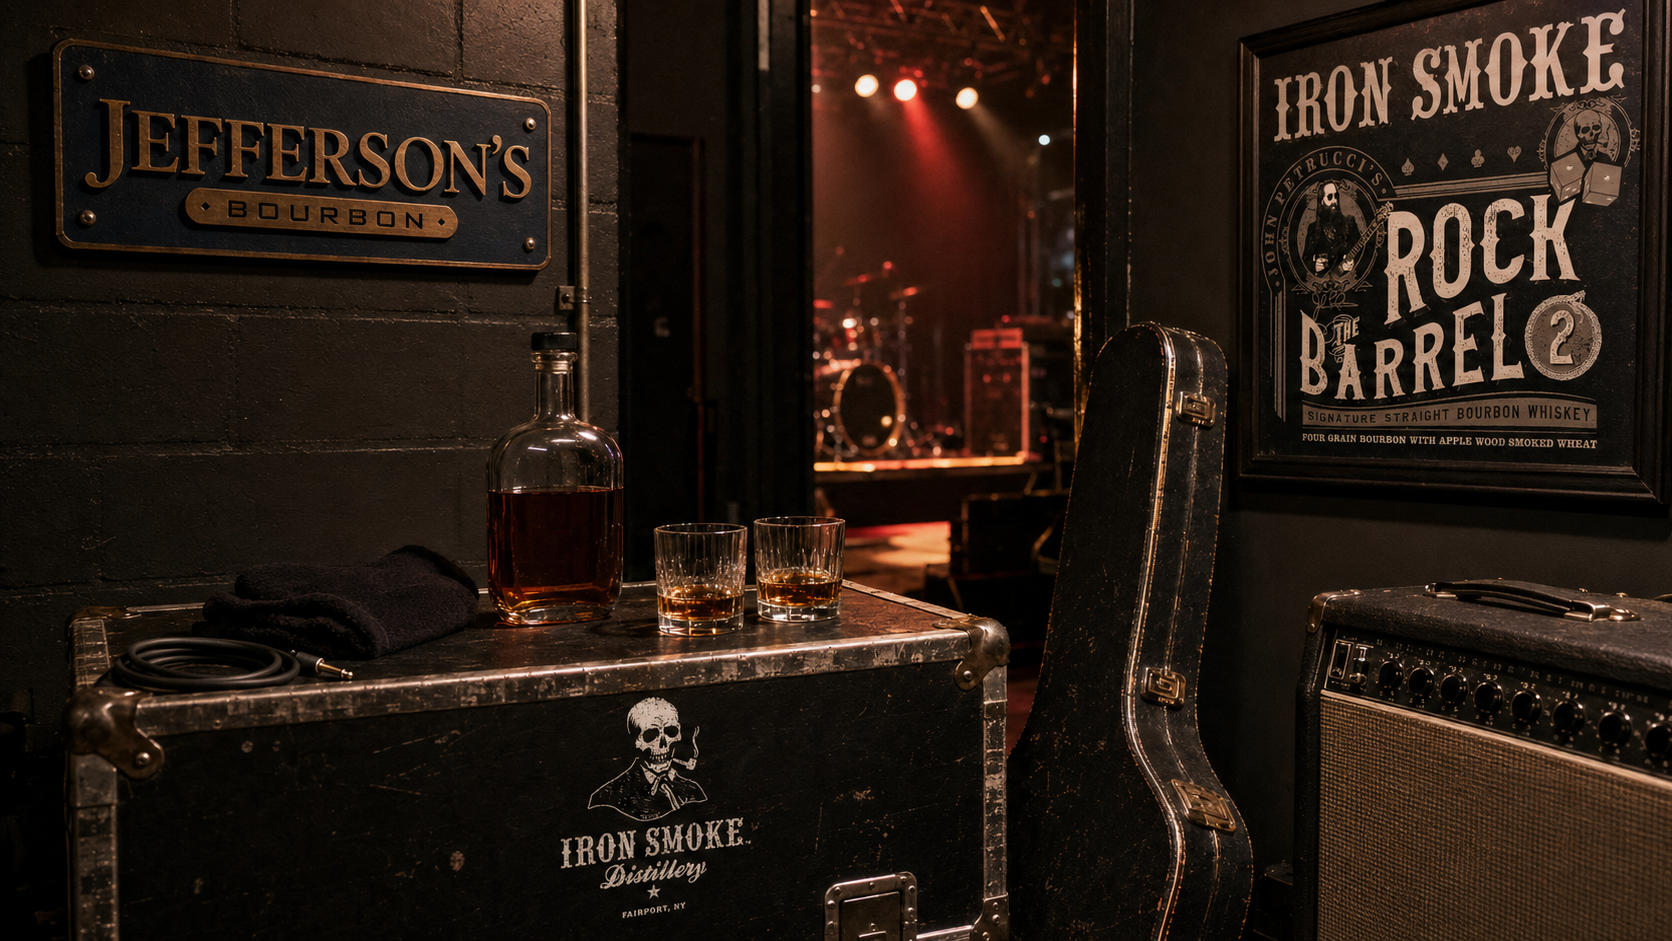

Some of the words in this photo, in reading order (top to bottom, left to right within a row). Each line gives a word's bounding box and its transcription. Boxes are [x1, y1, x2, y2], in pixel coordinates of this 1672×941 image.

[1273, 56, 1393, 142] IRON
[1410, 8, 1626, 121] SMOKE
[85, 99, 532, 199] JEFFERSON'S
[227, 200, 423, 229] BOURBON
[1264, 214, 1279, 277] JOHN
[1274, 151, 1383, 205] PETRUCCI'S
[1384, 194, 1581, 325] ROCK
[1299, 292, 1525, 400] BARREL
[1548, 309, 1575, 366] 2
[1333, 316, 1360, 347] THE
[1307, 410, 1377, 424] SIGNATURE
[1384, 408, 1450, 423] STRAIGHT
[1456, 404, 1520, 420] BOURBON
[1527, 404, 1591, 422] WHISKEY
[1302, 433, 1326, 442] FOUR
[1327, 434, 1357, 443] GRAIN
[1359, 434, 1407, 444] BOURBON
[1409, 435, 1437, 445] WITH
[1438, 436, 1473, 446] APPLE
[1475, 437, 1506, 447] WOOD
[1508, 438, 1554, 448] SMOKED
[1556, 439, 1598, 449] WHEAT
[560, 829, 637, 870] IRON
[645, 818, 744, 857] SMOKE
[600, 859, 707, 889] Distillery
[622, 904, 671, 919] FAIRPORT,
[673, 901, 687, 911] NY
